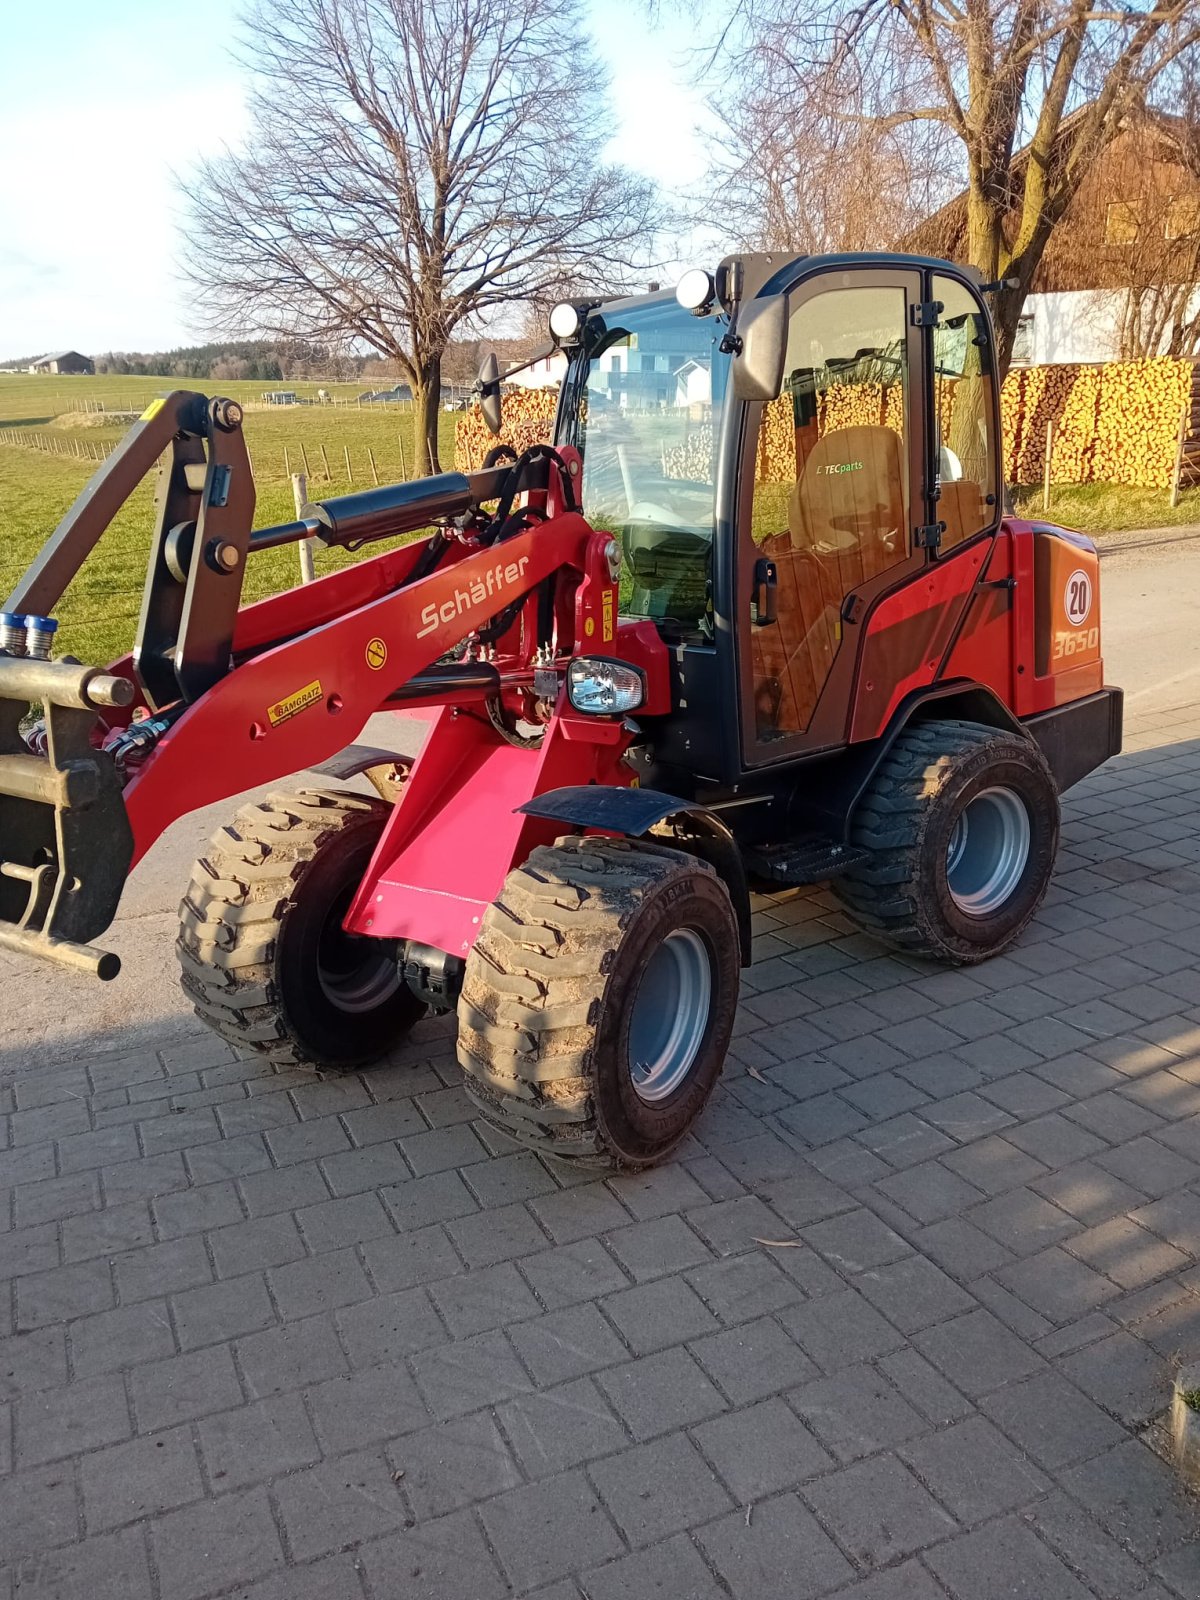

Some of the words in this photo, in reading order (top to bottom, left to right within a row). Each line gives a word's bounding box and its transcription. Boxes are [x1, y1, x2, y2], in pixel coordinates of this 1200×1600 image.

[825, 461, 863, 475] TECparts
[416, 556, 529, 639] Schäffer
[1070, 580, 1087, 615] 20
[1053, 626, 1099, 660] 3650
